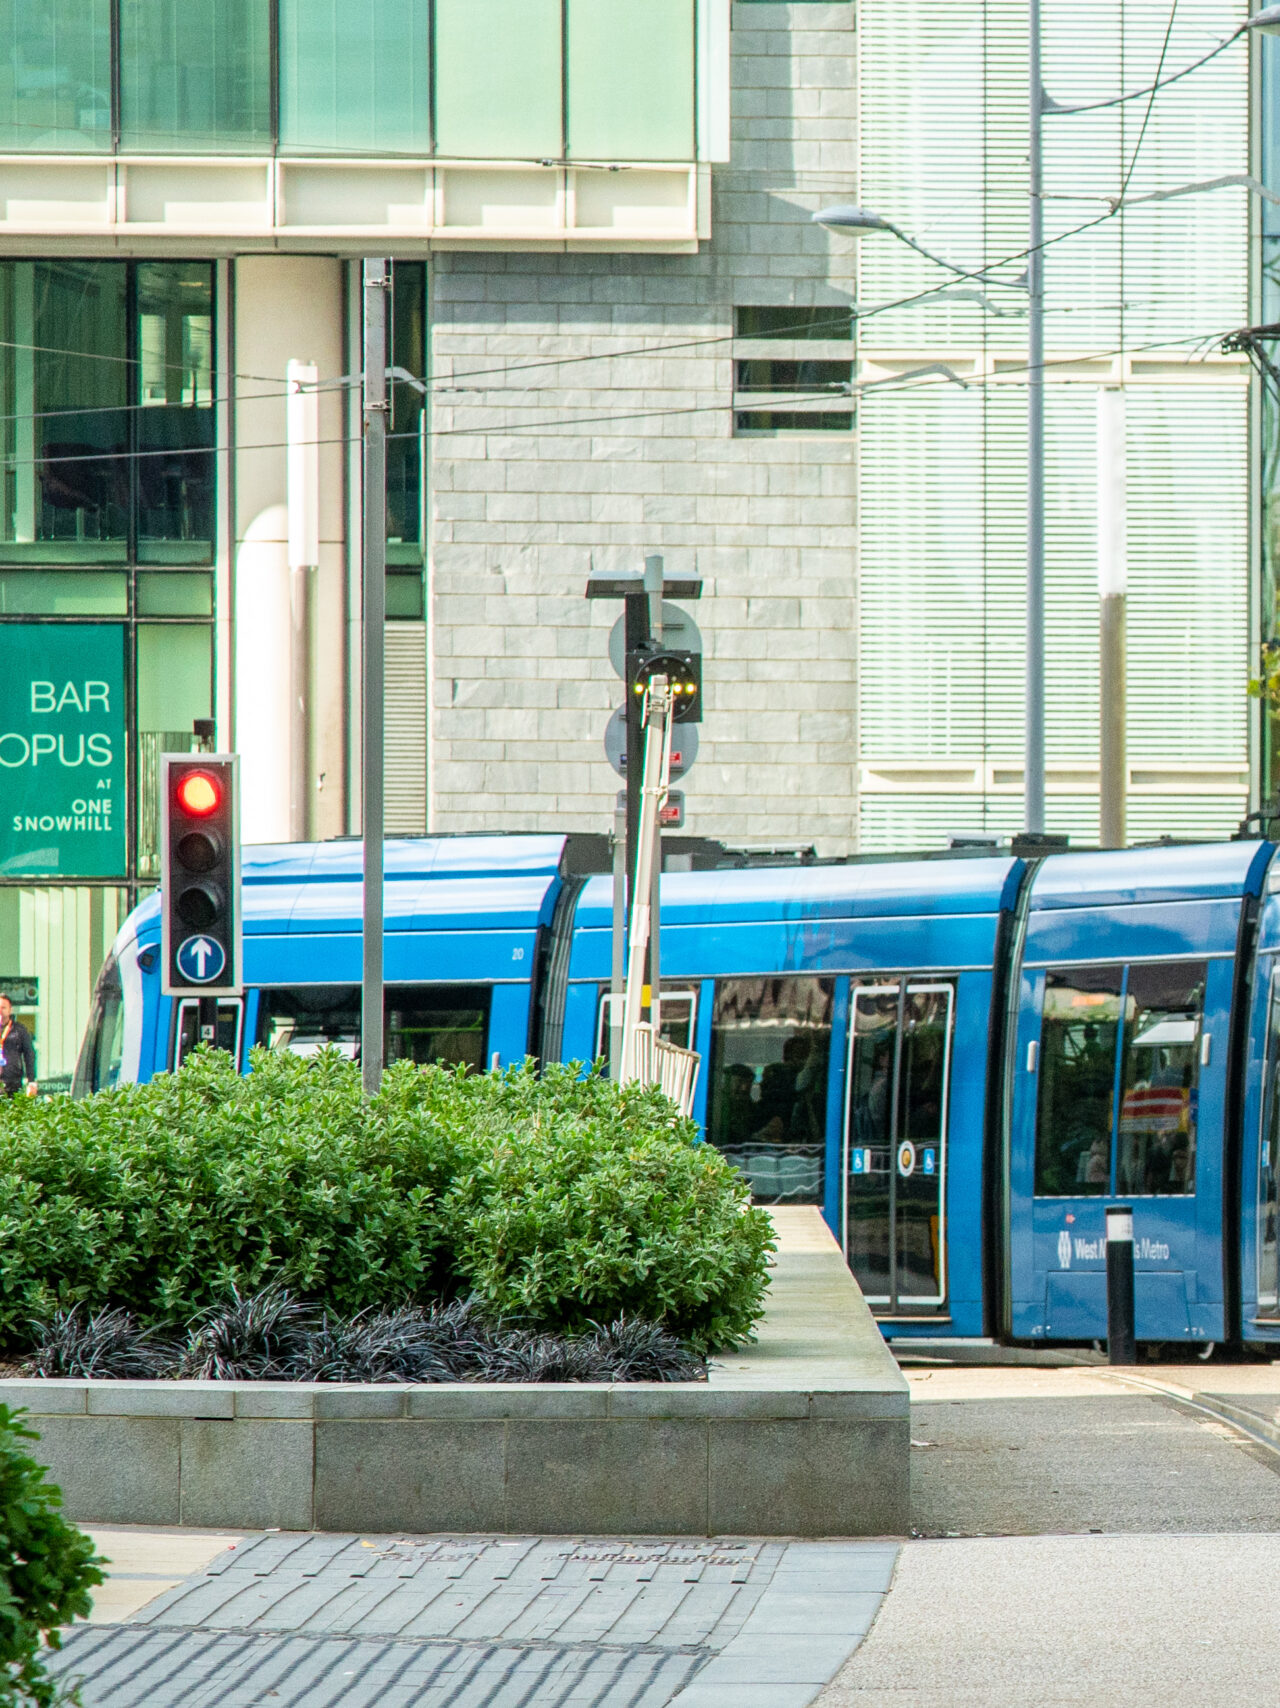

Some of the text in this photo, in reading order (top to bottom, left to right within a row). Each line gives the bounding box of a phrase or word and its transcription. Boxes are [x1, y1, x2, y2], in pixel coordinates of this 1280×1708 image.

[31, 680, 111, 713] BAR
[0, 733, 113, 768] OPUS
[96, 778, 112, 790] AT
[71, 798, 112, 815] ONE
[13, 815, 112, 832] SNOWHILL
[511, 947, 525, 961] 20
[204, 1027, 211, 1037] 4
[1074, 1238, 1098, 1259] West
[1141, 1238, 1170, 1260] Metro
